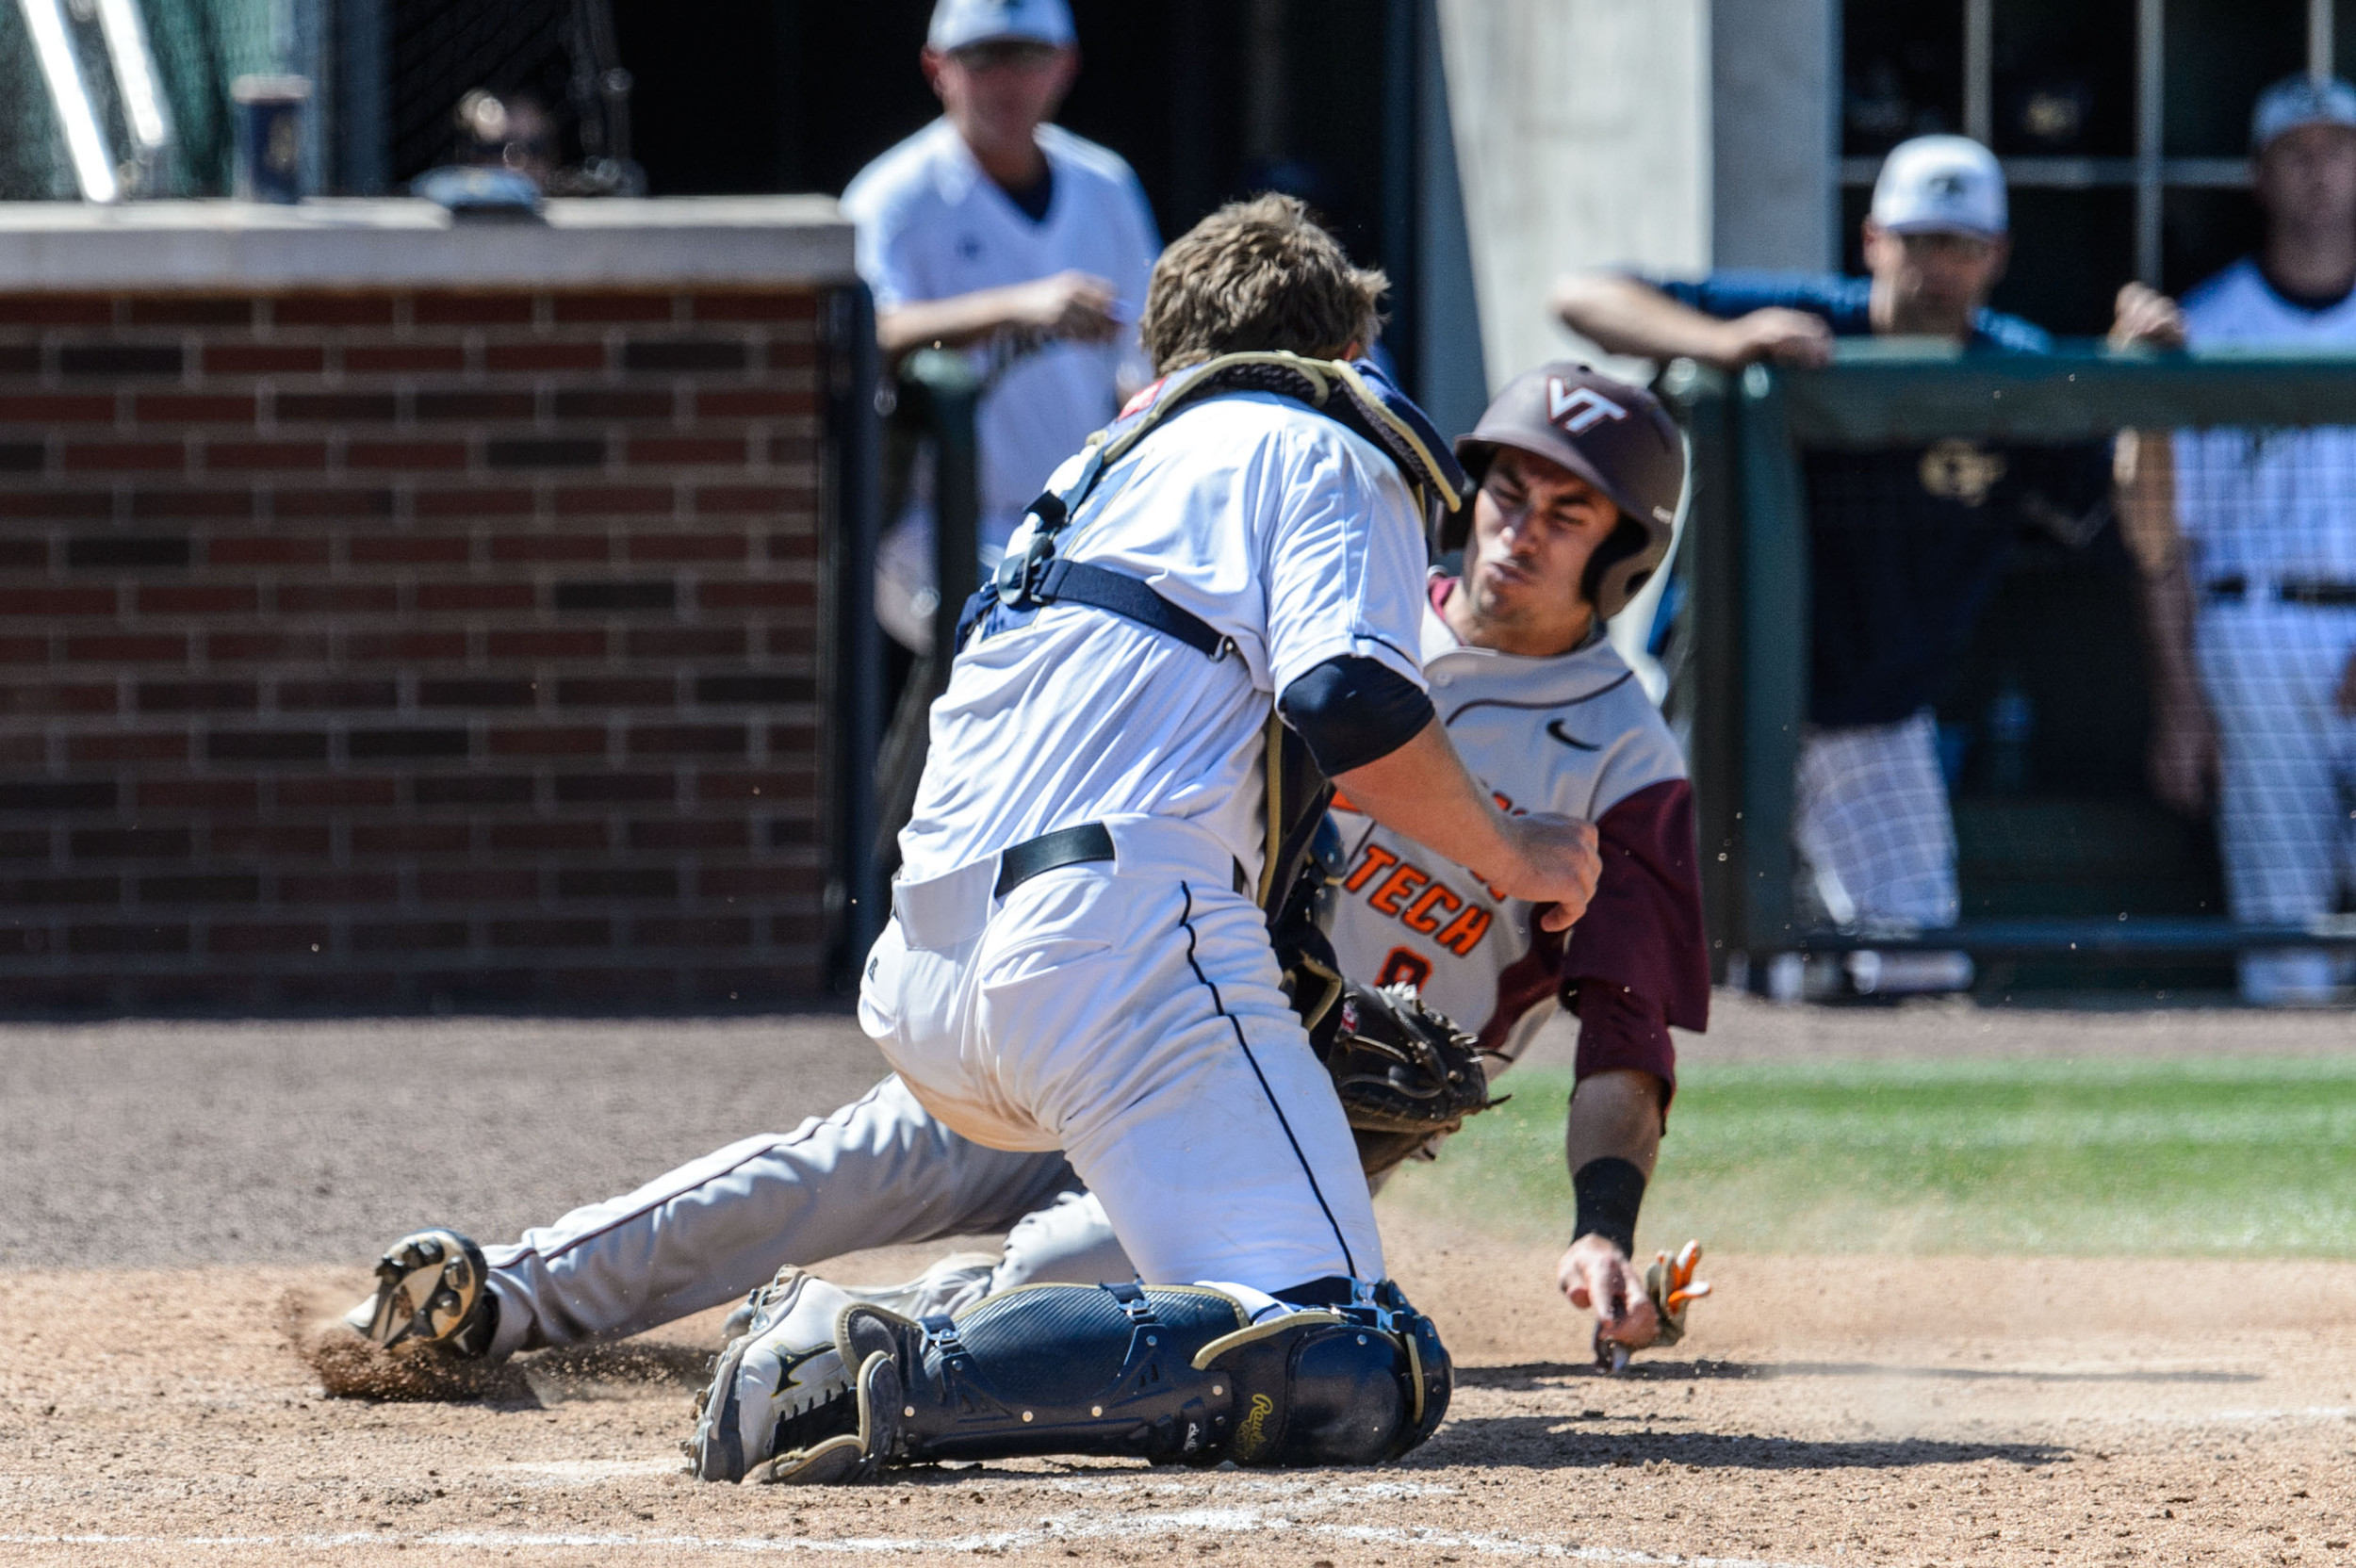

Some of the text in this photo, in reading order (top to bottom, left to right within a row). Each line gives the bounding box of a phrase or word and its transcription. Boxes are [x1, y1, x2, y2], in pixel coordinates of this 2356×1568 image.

[1547, 377, 1629, 434] VT
[1343, 843, 1495, 957] TECH
[1235, 1393, 1273, 1453] Rawl
